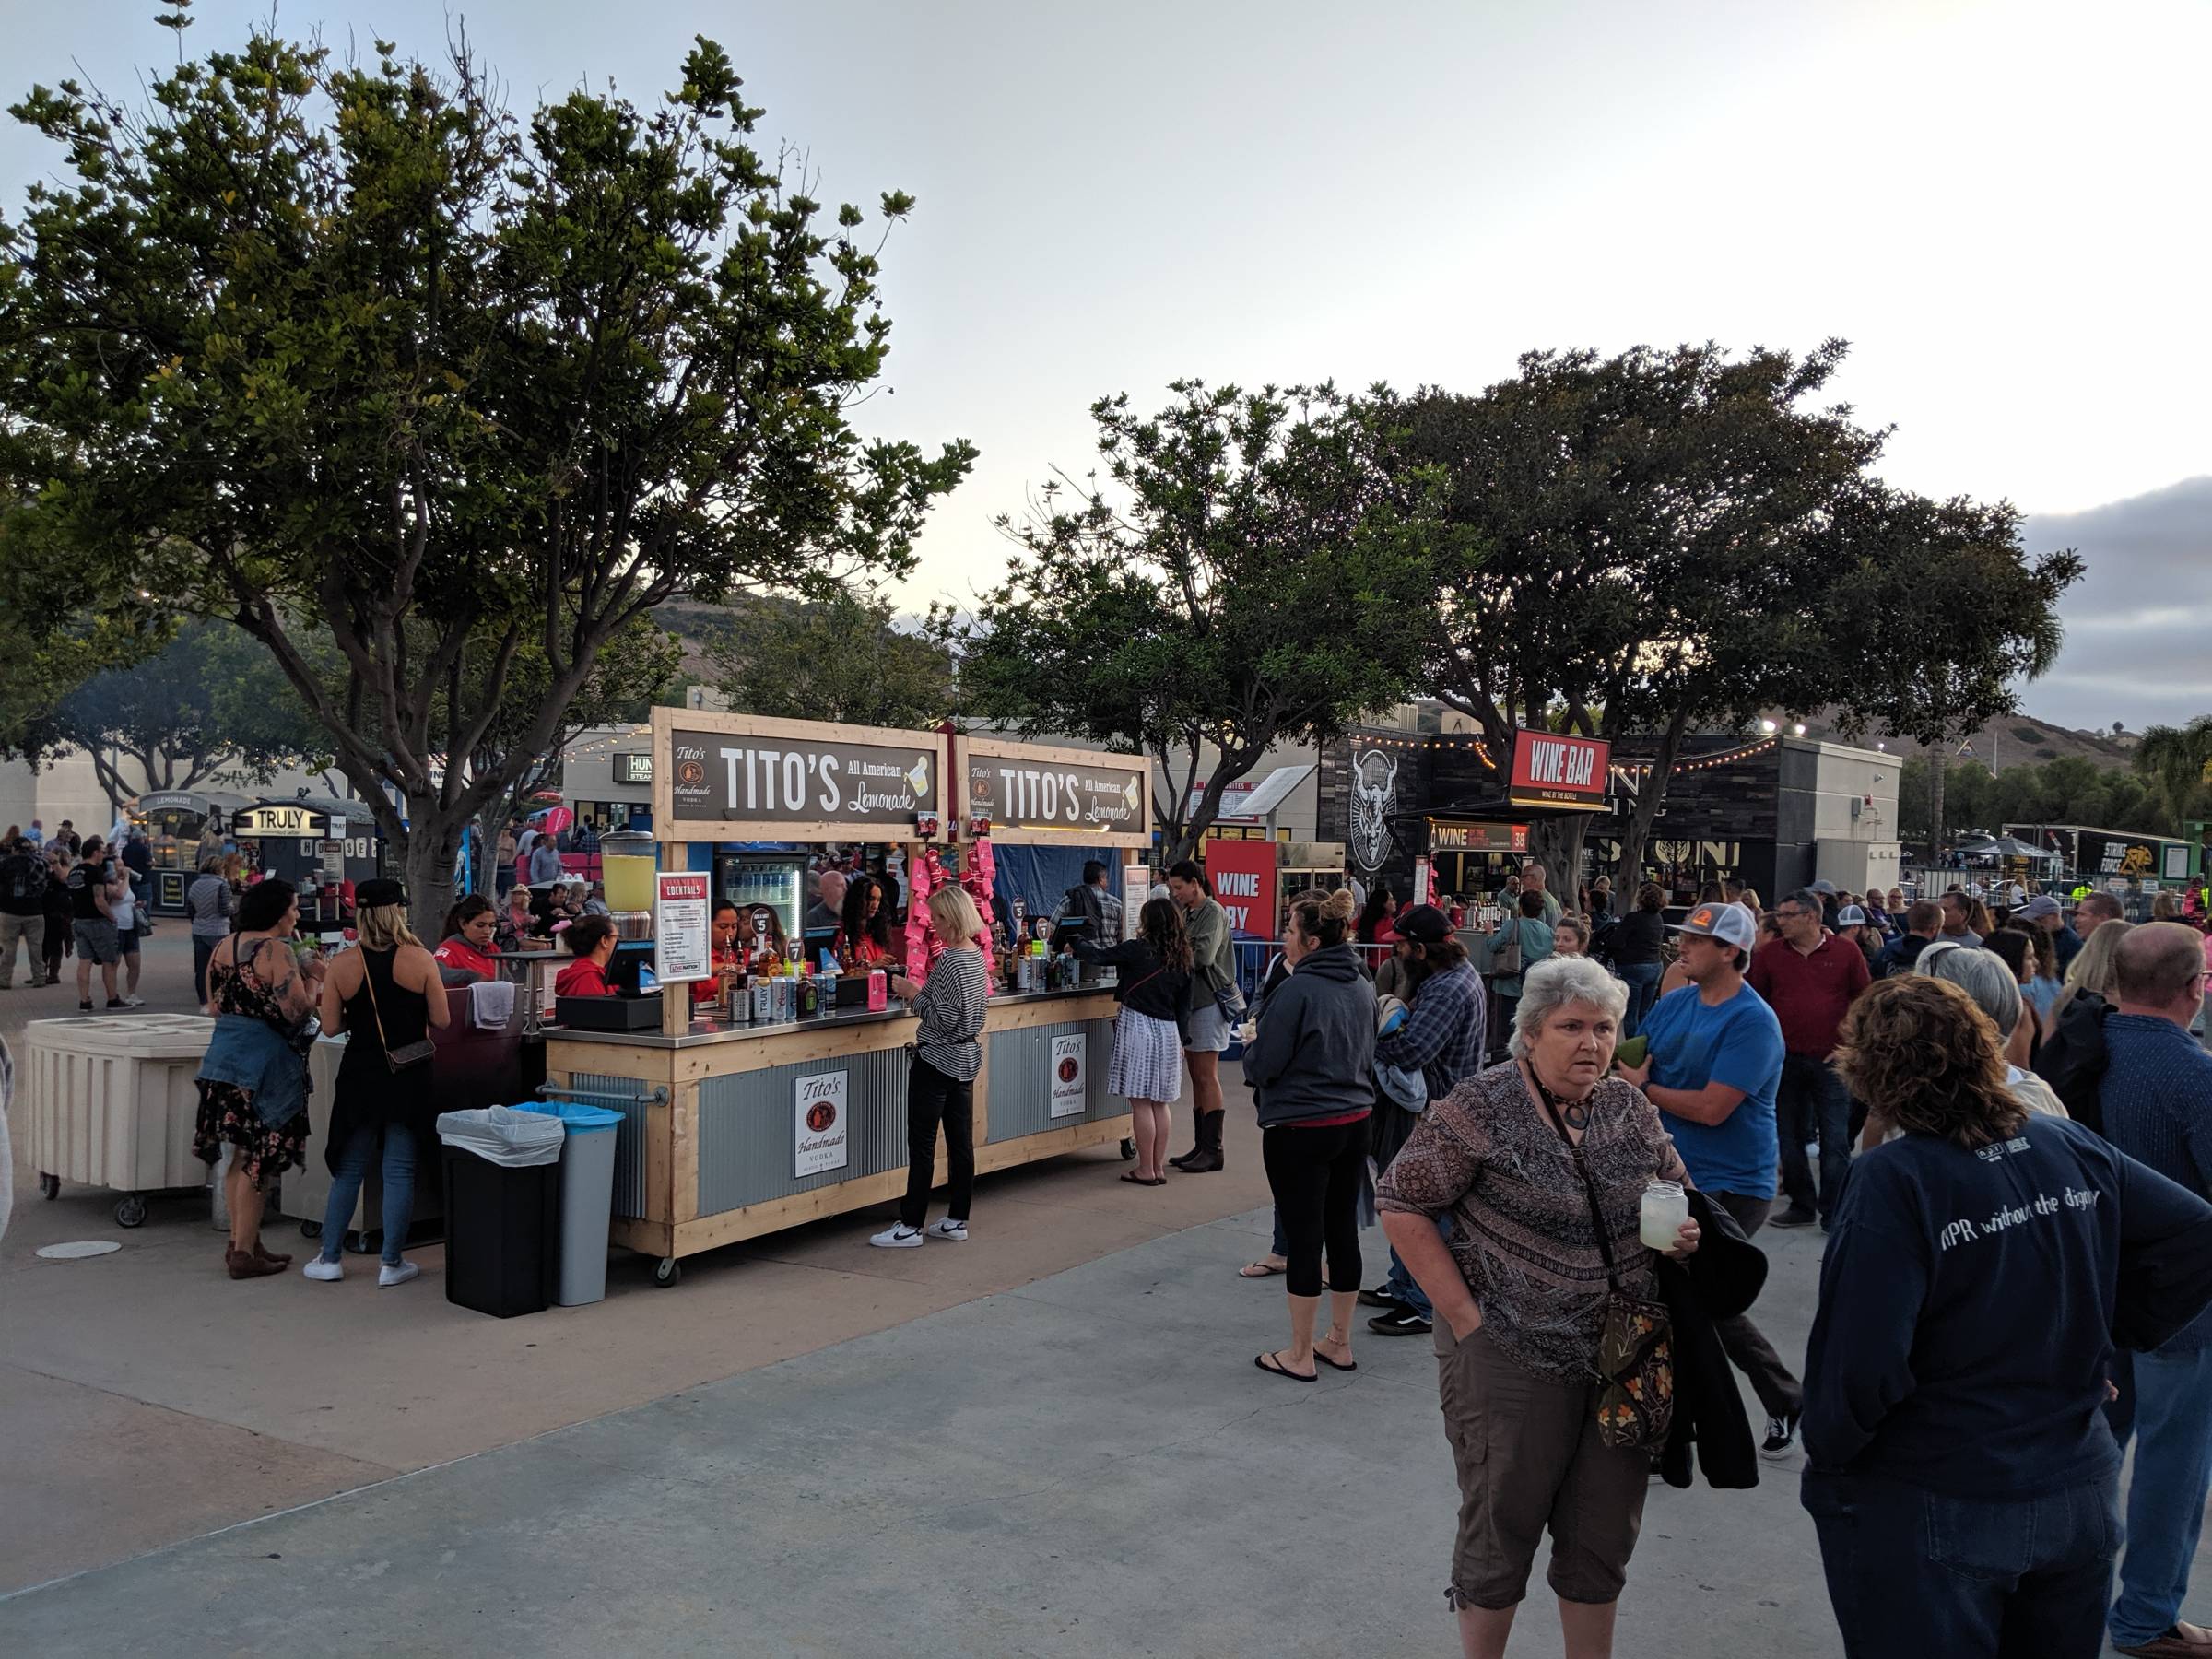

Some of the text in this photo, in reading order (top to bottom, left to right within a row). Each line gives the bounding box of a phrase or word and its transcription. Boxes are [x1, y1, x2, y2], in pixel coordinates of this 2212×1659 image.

[677, 746, 706, 759] Tito's
[847, 761, 901, 778] All American
[1530, 740, 1566, 783] WINE
[1565, 745, 1594, 785] BAR
[720, 747, 840, 812] TITO'S
[971, 767, 992, 779] Tito's
[674, 784, 711, 795] Handmade
[999, 768, 1080, 821] TITO'S
[1085, 780, 1121, 794] All American
[847, 781, 916, 814] Lemonade
[1084, 796, 1132, 823] Lemonade
[257, 810, 304, 829] TRULY
[1438, 828, 1468, 846] WINE
[1514, 832, 1525, 847] 38
[2104, 842, 2128, 857] STRIKE
[666, 885, 700, 896] COCKTAILS
[1217, 872, 1260, 897] WINE
[1226, 906, 1250, 930] BY
[1056, 1038, 1082, 1056] Tito's
[803, 1077, 841, 1100] Tito's
[798, 1130, 845, 1154] Handmade
[810, 1152, 833, 1162] VODKA
[1940, 1218, 1979, 1251] NPR
[2034, 1193, 2059, 1216] the
